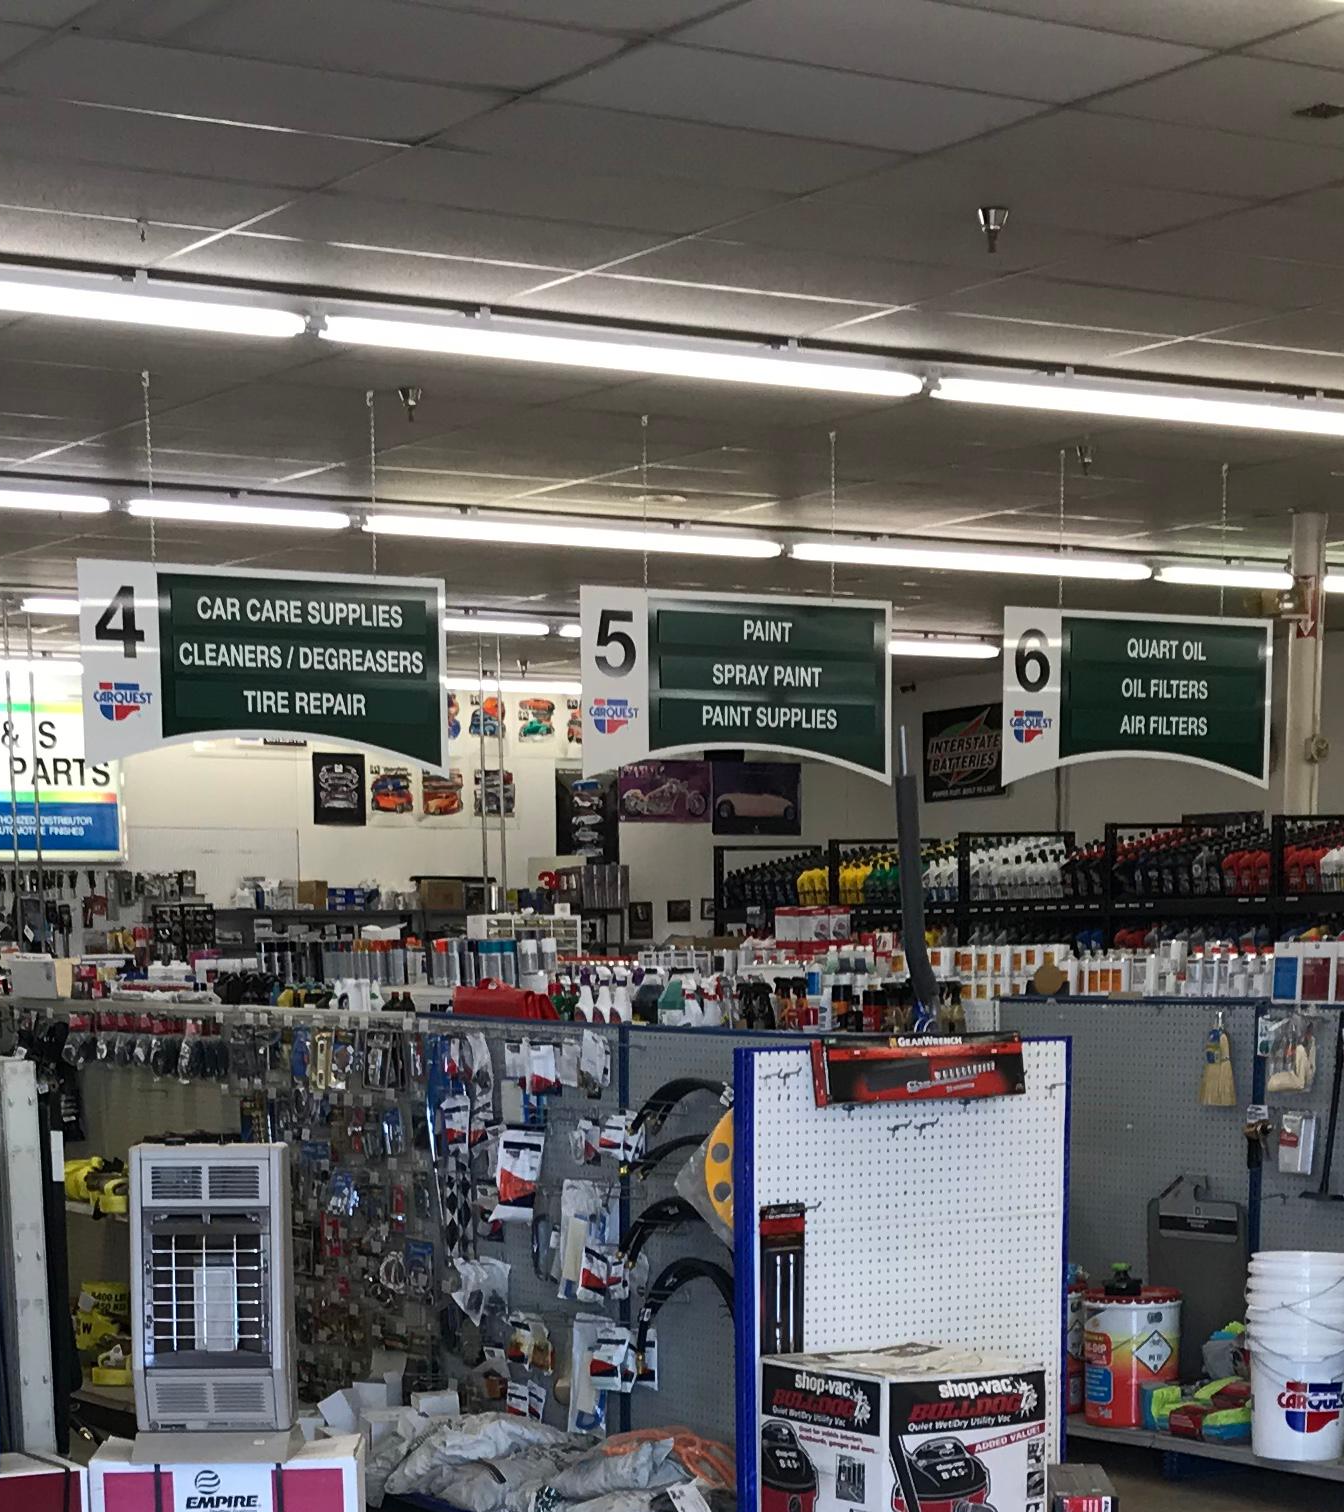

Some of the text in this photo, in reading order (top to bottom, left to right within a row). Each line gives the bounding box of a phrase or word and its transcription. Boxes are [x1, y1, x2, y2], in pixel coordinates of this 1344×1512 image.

[95, 585, 144, 658] 4
[197, 596, 403, 628] CAR CARE SUPPLIES
[743, 620, 792, 643] PAINT
[595, 609, 636, 678] 5
[1127, 638, 1206, 661] QUART OIL
[179, 642, 423, 674] CLEANERS / DEGREASERS
[1015, 629, 1050, 693] 6
[712, 664, 822, 687] SPRAY PAINT
[93, 691, 153, 705] CARQUEST
[1122, 678, 1208, 700] OIL FILTERS
[243, 690, 367, 716] TIRE REPAIR
[589, 706, 639, 719] CARQUEST
[702, 706, 837, 730] PAINT SUPPLIES
[1010, 717, 1052, 729] CARQUEST
[1120, 715, 1208, 736] AIR FILTERS
[1, 721, 19, 748] &
[38, 721, 57, 749] S
[930, 735, 1001, 753] INTERSTATE
[10, 757, 111, 786] PARTS
[932, 754, 996, 774] BATTERIES
[908, 1422, 933, 1432] Quiet
[971, 1416, 996, 1427] Utility
[998, 1415, 1011, 1423] Vac
[975, 1424, 1041, 1453] ADDED VALUE!
[186, 1495, 258, 1509] EMPIRE
